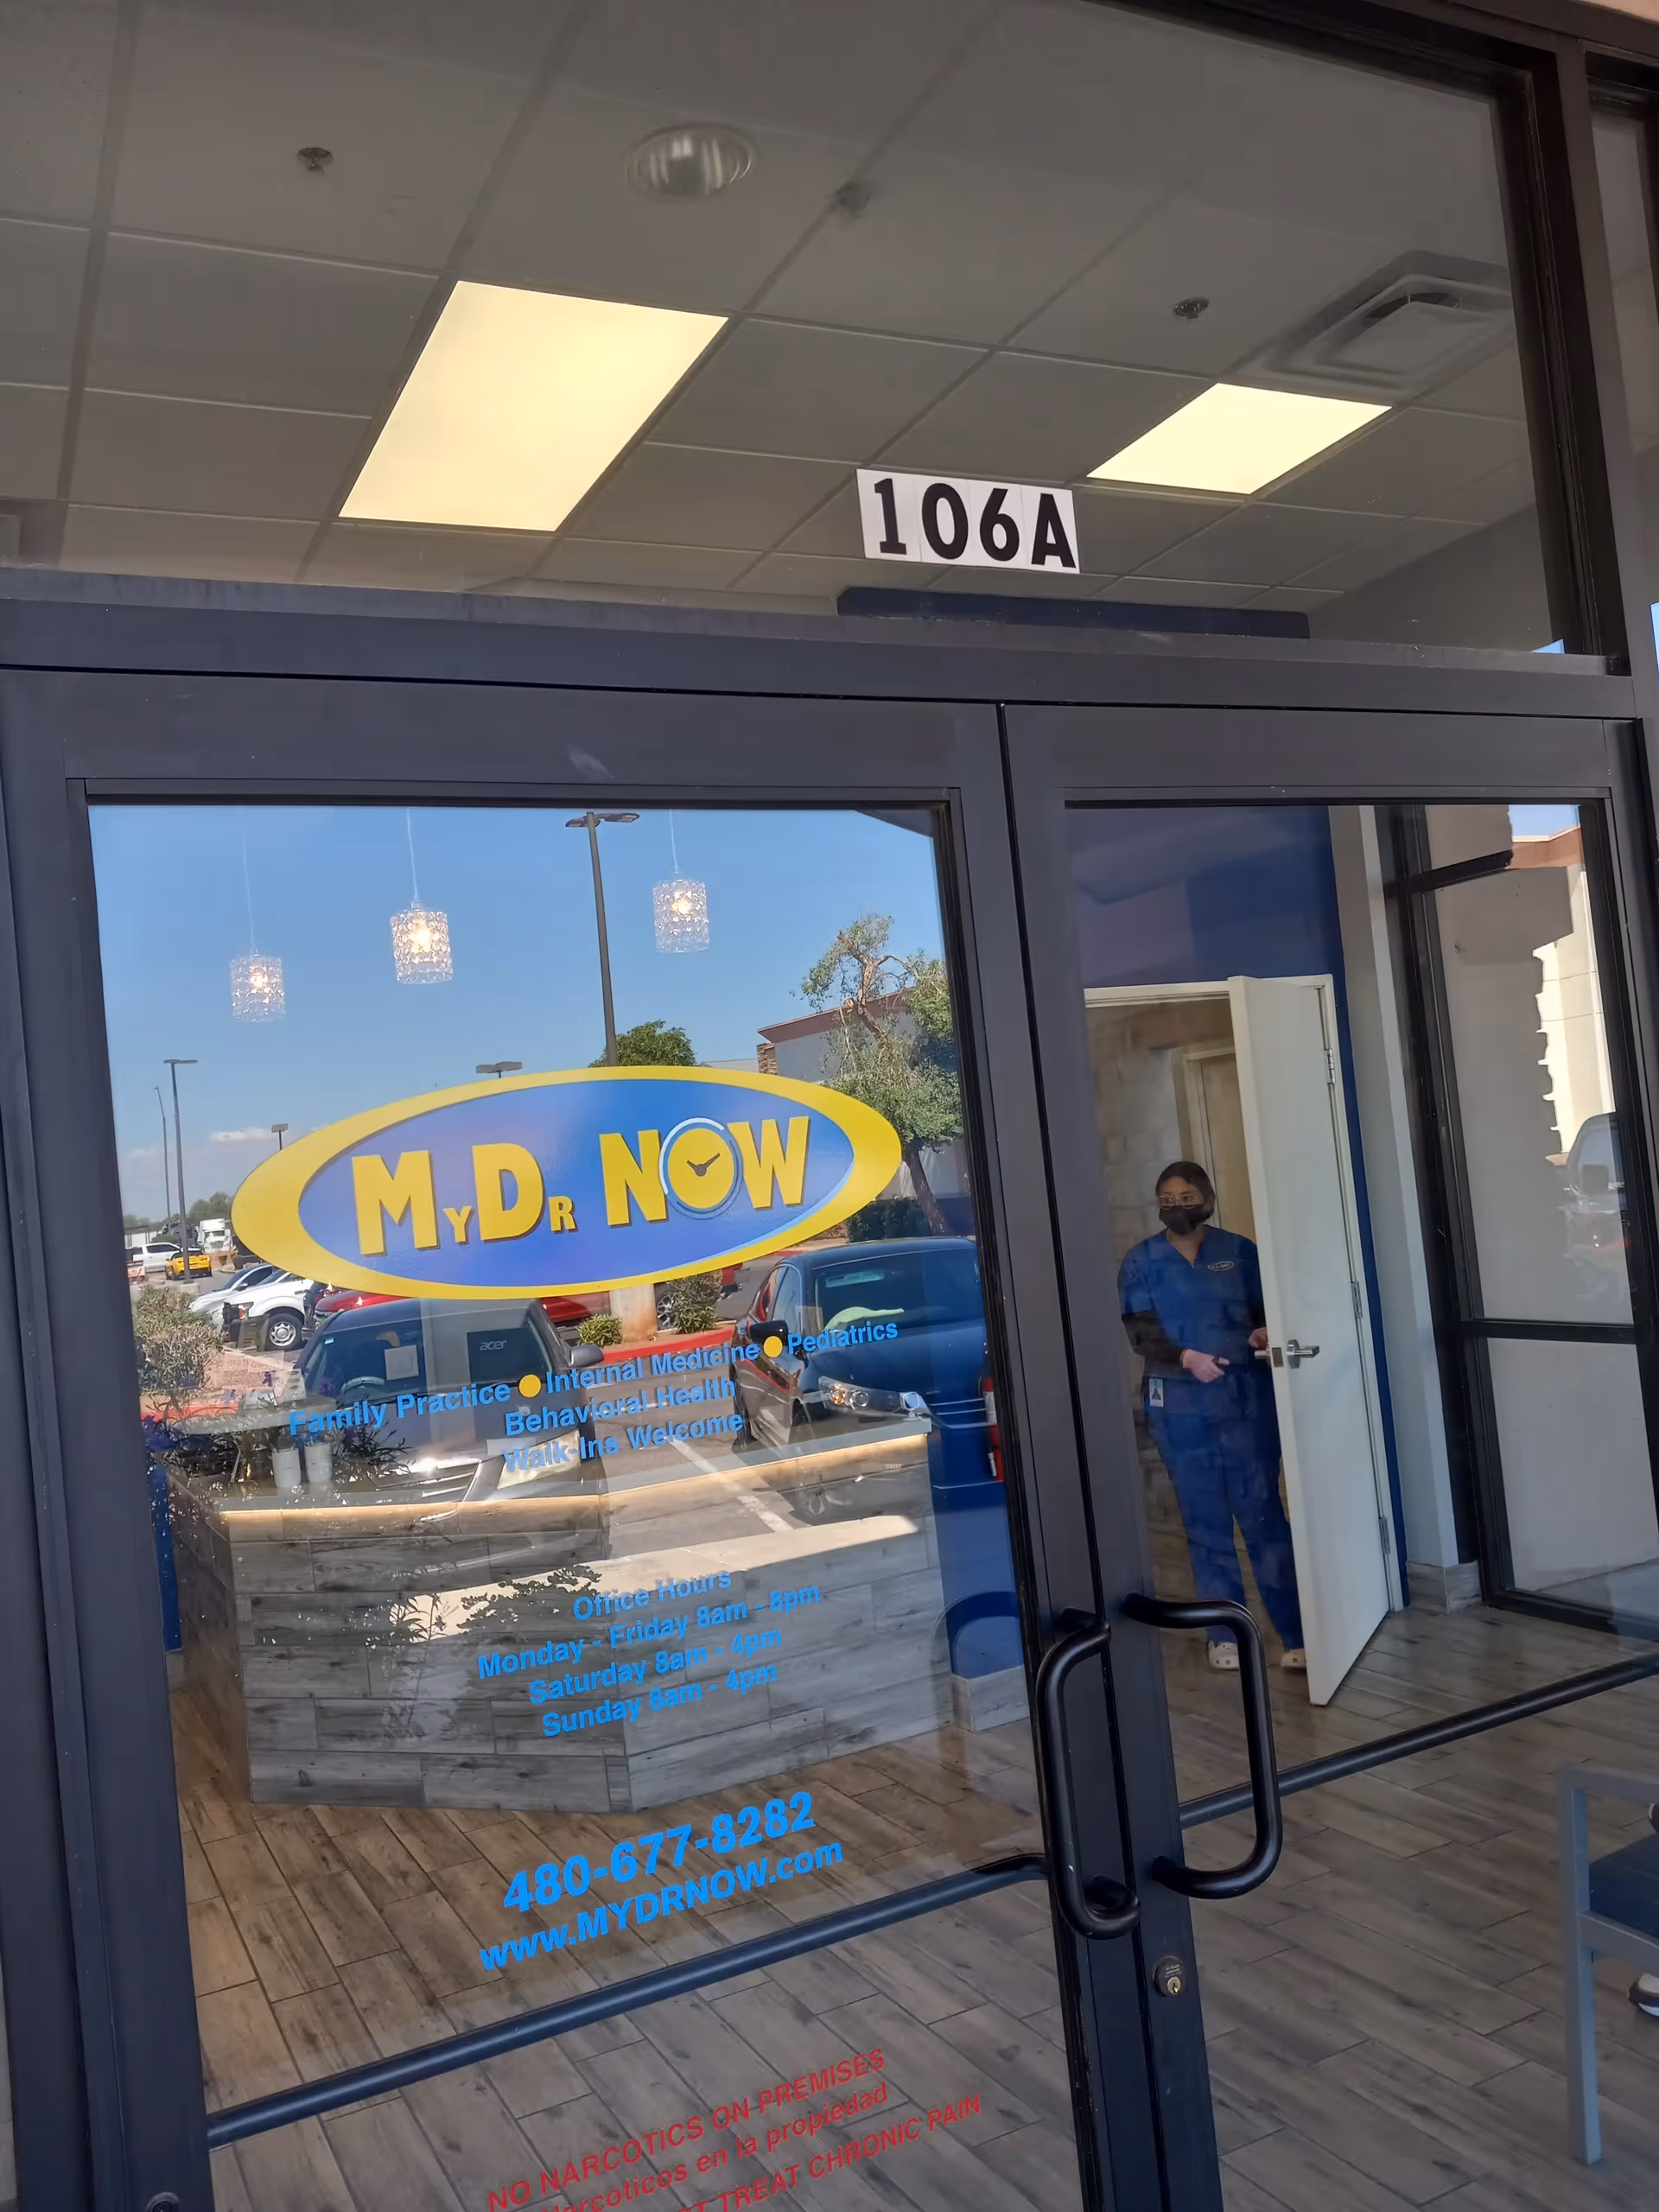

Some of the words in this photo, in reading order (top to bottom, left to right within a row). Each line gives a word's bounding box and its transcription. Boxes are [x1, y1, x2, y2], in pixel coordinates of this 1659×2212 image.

[874, 478, 1077, 568] 106A
[599, 1116, 809, 1226] NOW
[289, 1400, 387, 1436] Family
[397, 1383, 511, 1418] Practice
[546, 1355, 642, 1394] Internal
[652, 1341, 760, 1374] Medicine
[787, 1319, 899, 1355] Pediatrics
[480, 1340, 508, 1351] acer
[503, 1427, 620, 1473] Walk-Ins
[626, 1412, 743, 1451] Welcome
[505, 1390, 647, 1436] Behavioral
[657, 1376, 735, 1408] Health
[477, 1640, 584, 1679] Monday
[608, 1614, 688, 1649] Friday
[696, 1602, 747, 1629] 8am
[769, 1584, 820, 1614] 8pm
[572, 1591, 650, 1620] Office
[658, 1570, 732, 1602] Hours
[528, 1661, 647, 1705] Saturday
[655, 1646, 707, 1674] 8am
[730, 1627, 782, 1658] 4pm
[542, 1699, 642, 1737] Sunday
[649, 1683, 702, 1711] 8am
[725, 1664, 777, 1695] 4pm
[503, 1791, 815, 1912] 480-677-8282
[478, 1841, 843, 1971] www.MYDRNOW.com
[486, 2179, 531, 2212] NO
[539, 2114, 704, 2196] NARCOTICS
[712, 2098, 751, 2131] ON
[757, 2048, 886, 2113] PREMISES
[541, 2164, 689, 2212] rcoticos
[696, 2146, 728, 2174] en
[736, 2136, 758, 2159] la
[766, 2081, 888, 2153] propiedad
[716, 2163, 801, 2212] TREAT
[809, 2117, 921, 2179] CHRONIC
[927, 2092, 982, 2133] PAIN
